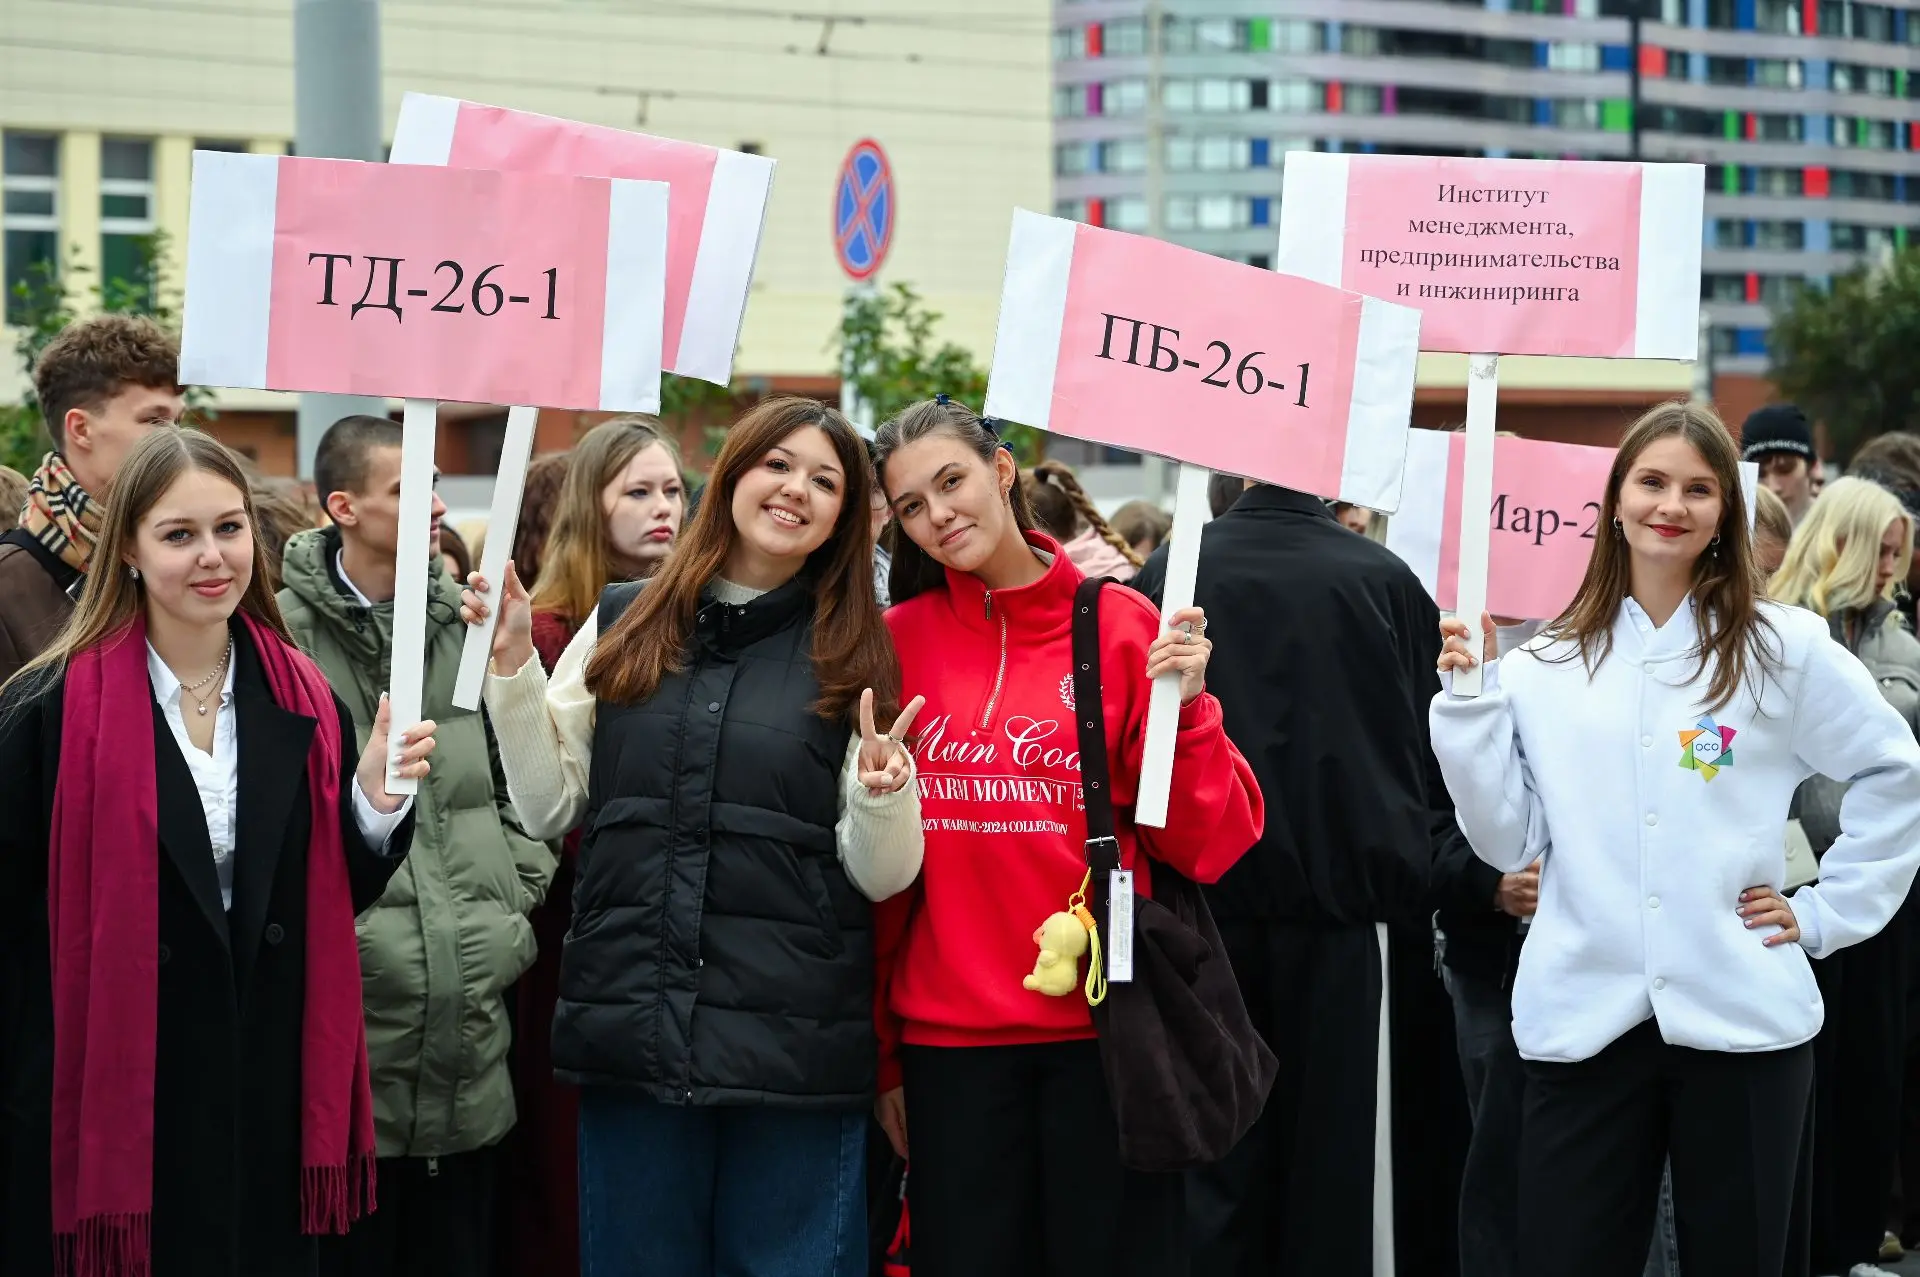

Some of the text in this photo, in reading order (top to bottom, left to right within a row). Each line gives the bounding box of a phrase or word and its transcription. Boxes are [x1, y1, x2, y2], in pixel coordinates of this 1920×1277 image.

[1438, 184, 1550, 207] Институт
[1408, 219, 1574, 239] менеджмента,
[1360, 249, 1620, 272] предпринимательства
[308, 252, 561, 325] ТД-26-1
[1397, 283, 1580, 305] и инжиниринга
[1095, 312, 1310, 409] ПБ-26-1
[916, 777, 1066, 805] WARM MOMENT
[1008, 820, 1068, 836] COLLECTION
